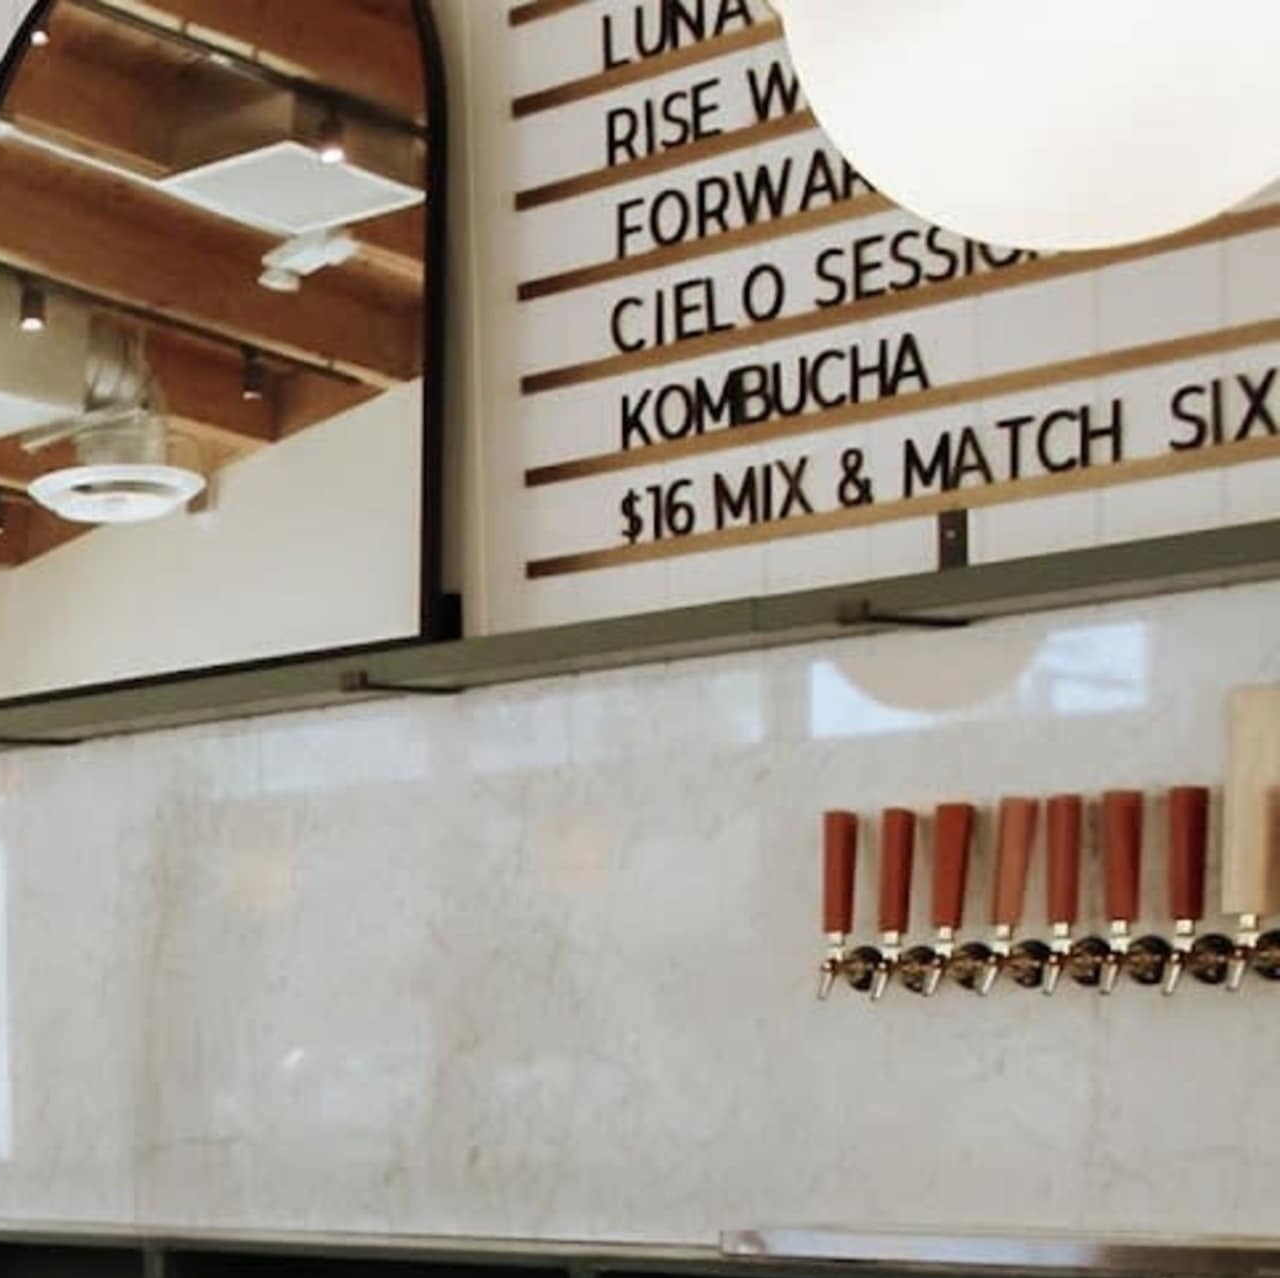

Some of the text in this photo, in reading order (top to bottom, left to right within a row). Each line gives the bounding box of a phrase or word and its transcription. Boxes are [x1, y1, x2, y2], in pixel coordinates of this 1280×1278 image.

[603, 0, 753, 69] LUNA
[606, 78, 722, 167] RISE
[610, 262, 785, 354] CIELO
[621, 333, 930, 450] KOMBUCHA
[621, 368, 1278, 545] $16 MIX & MATCH SIX
